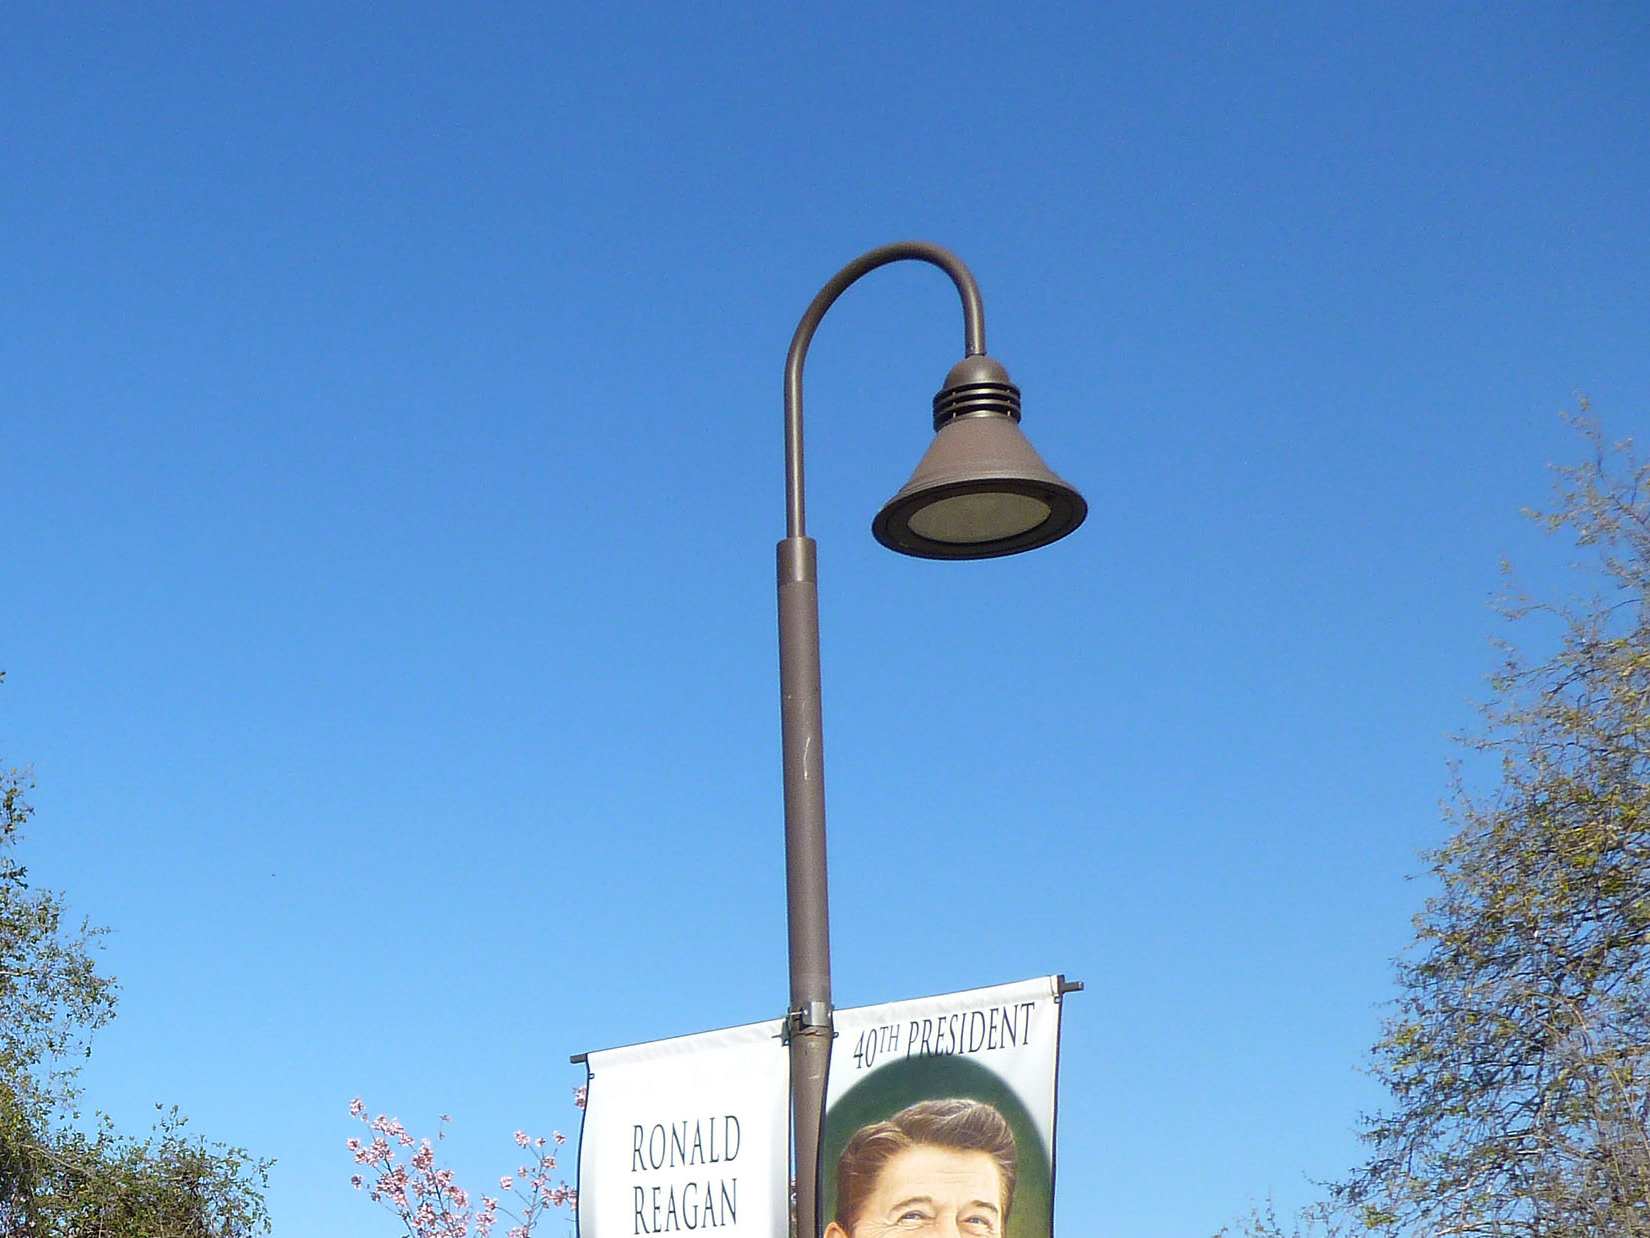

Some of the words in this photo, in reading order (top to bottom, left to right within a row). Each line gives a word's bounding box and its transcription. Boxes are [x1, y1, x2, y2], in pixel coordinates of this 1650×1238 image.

[853, 1024, 900, 1069] 40TH
[906, 1002, 1035, 1060] PRESIDENT
[631, 1115, 741, 1172] RONALD
[633, 1178, 738, 1236] REAGAN
